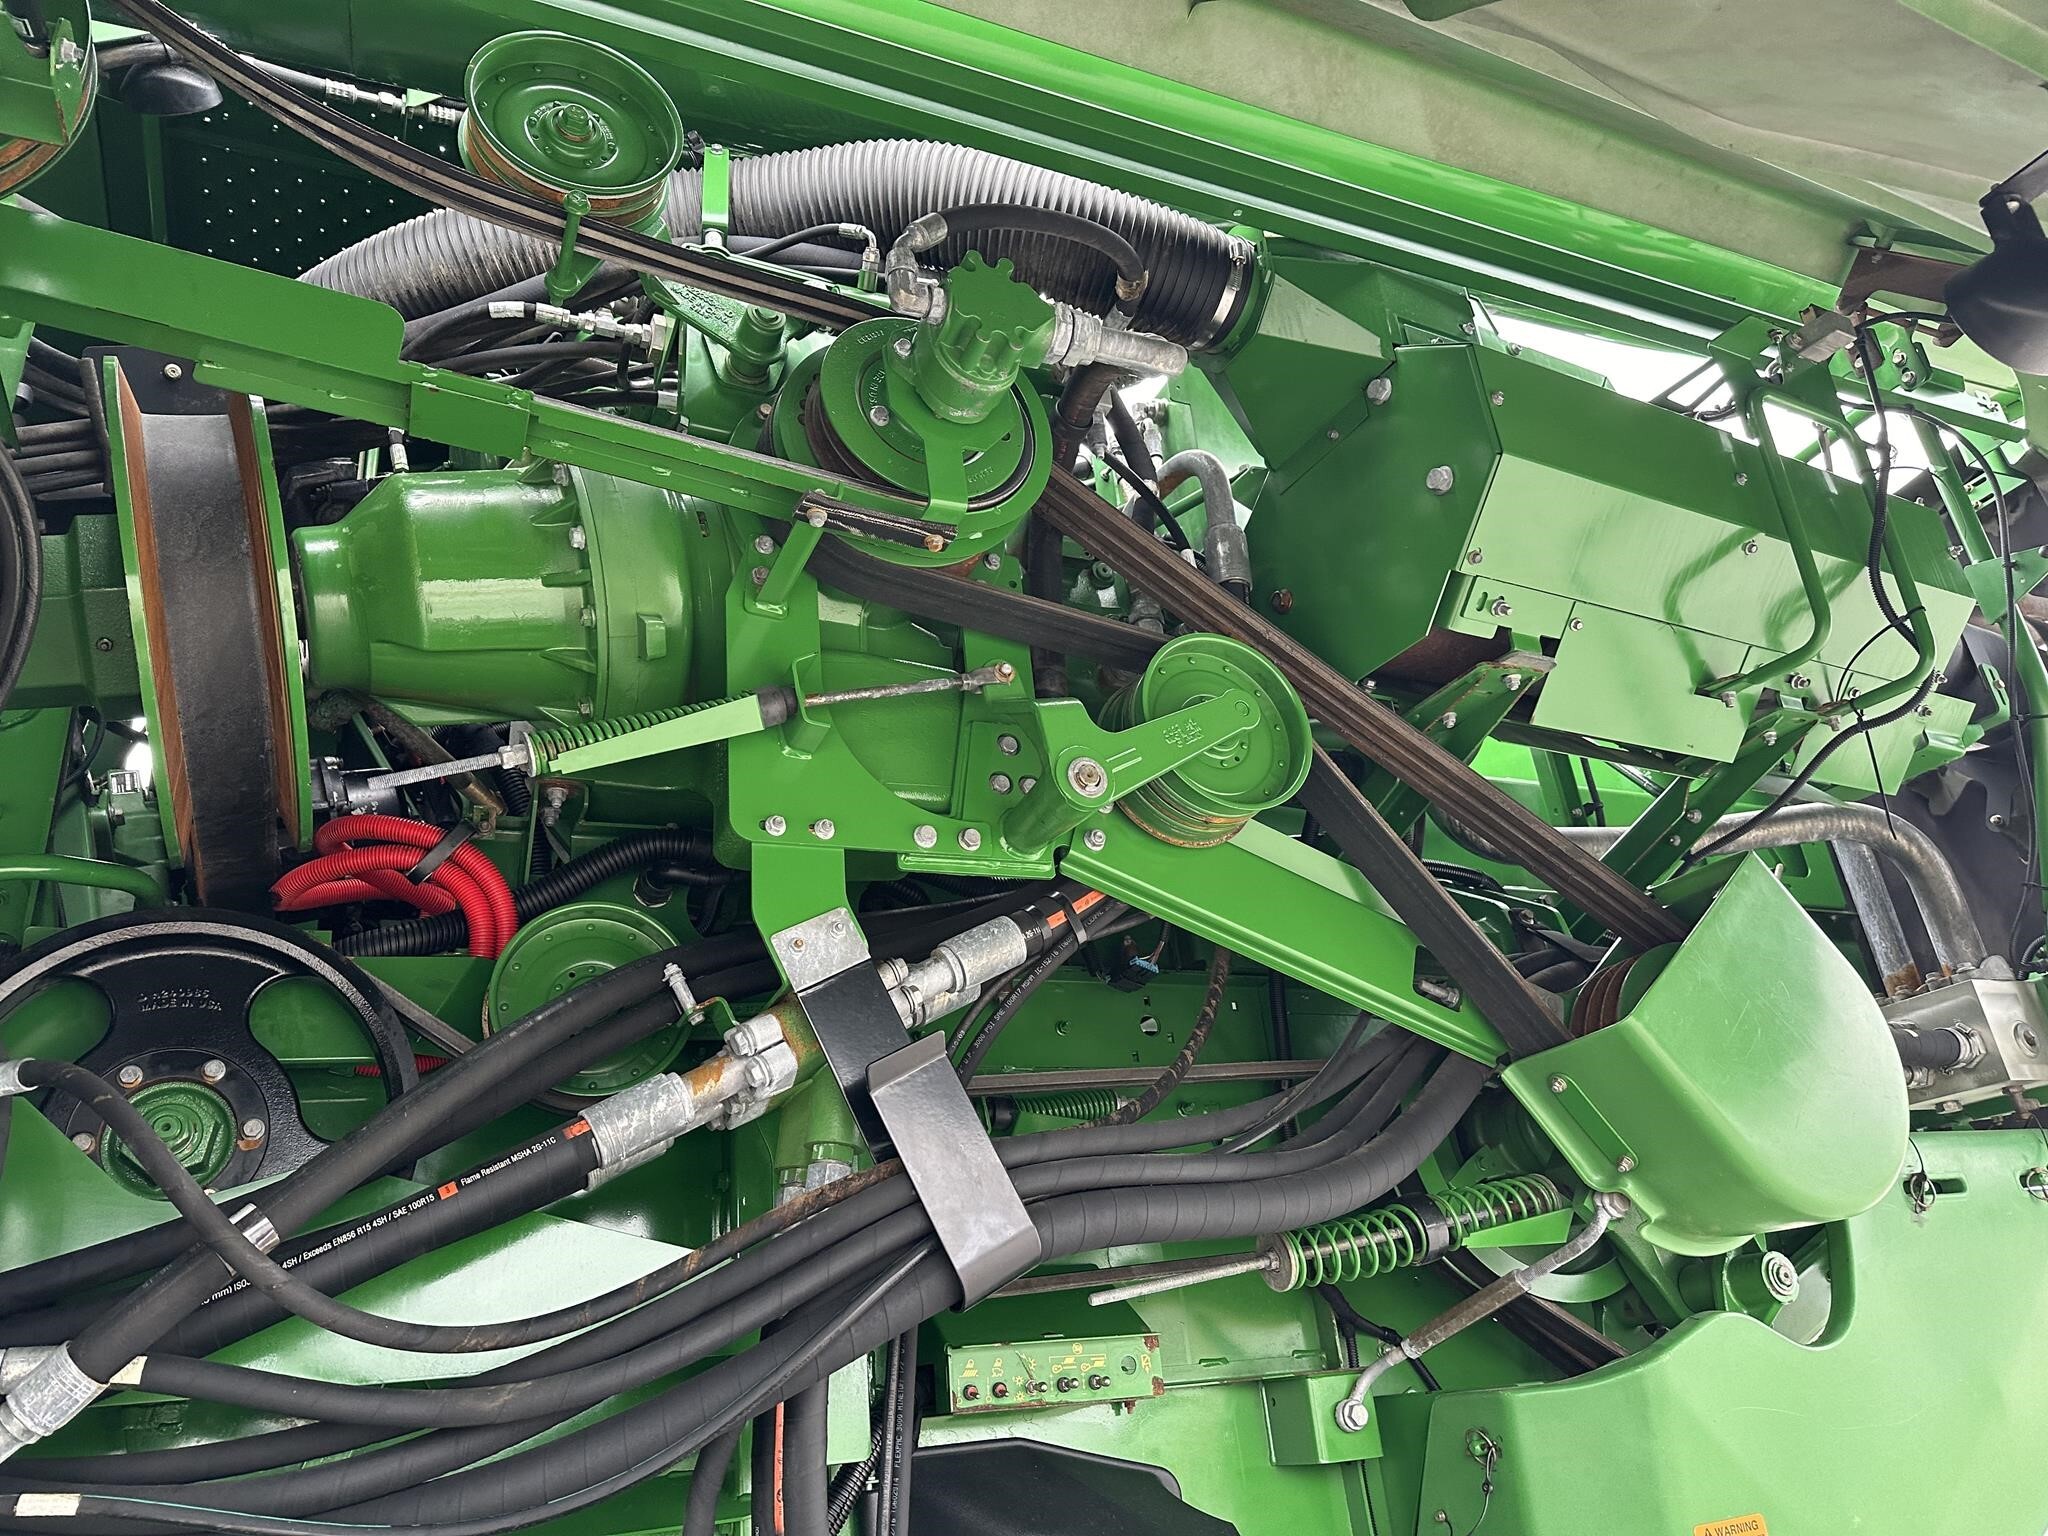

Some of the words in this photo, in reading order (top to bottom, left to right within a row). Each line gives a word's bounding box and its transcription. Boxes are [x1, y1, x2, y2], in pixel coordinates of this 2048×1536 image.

[211, 1286, 232, 1301] mm)
[233, 1279, 251, 1292] ISO
[282, 1256, 298, 1269] 4SH
[303, 1242, 332, 1260] Exceeds
[332, 1230, 357, 1247] EN856
[356, 1223, 372, 1236] R15
[372, 1215, 388, 1228] 4SH
[392, 1205, 408, 1219] SAE
[407, 1193, 435, 1211] 100R15
[460, 1173, 481, 1186] Flame
[480, 1158, 512, 1177] Resistant
[510, 1148, 532, 1164] MSHA
[531, 1136, 557, 1153] 2G-11C
[1714, 1520, 1759, 1536] WARNING
